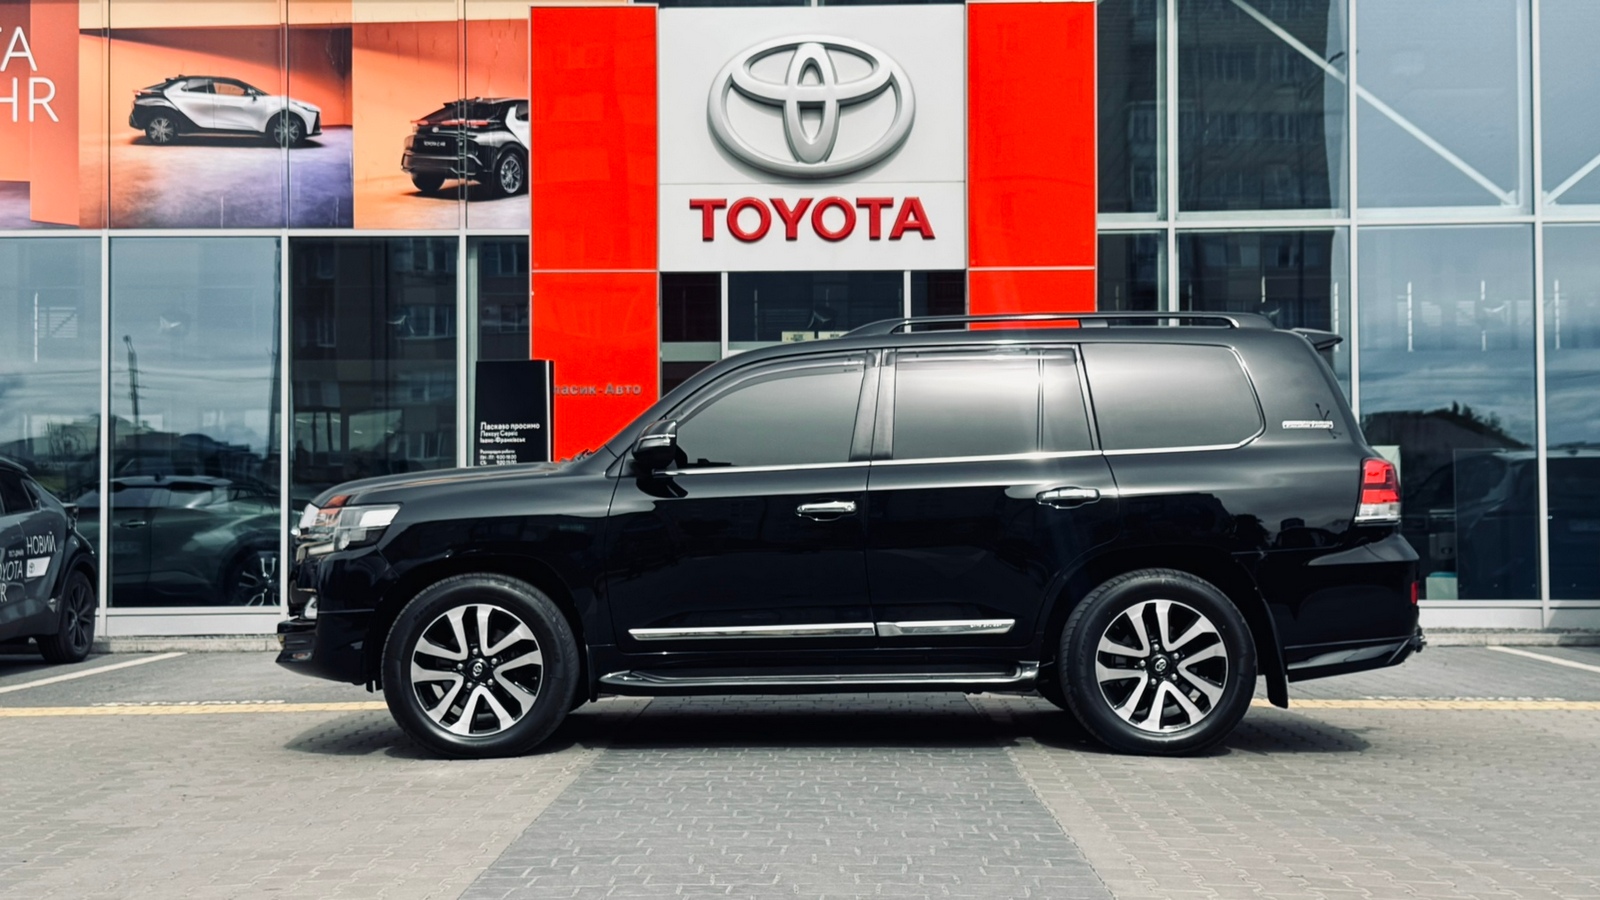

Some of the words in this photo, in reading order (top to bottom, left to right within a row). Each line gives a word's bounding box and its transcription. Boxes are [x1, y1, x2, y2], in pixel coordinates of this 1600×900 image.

[0, 26, 38, 72] A
[689, 196, 936, 243] TOYOTA
[26, 531, 57, 554] НОВИЙ
